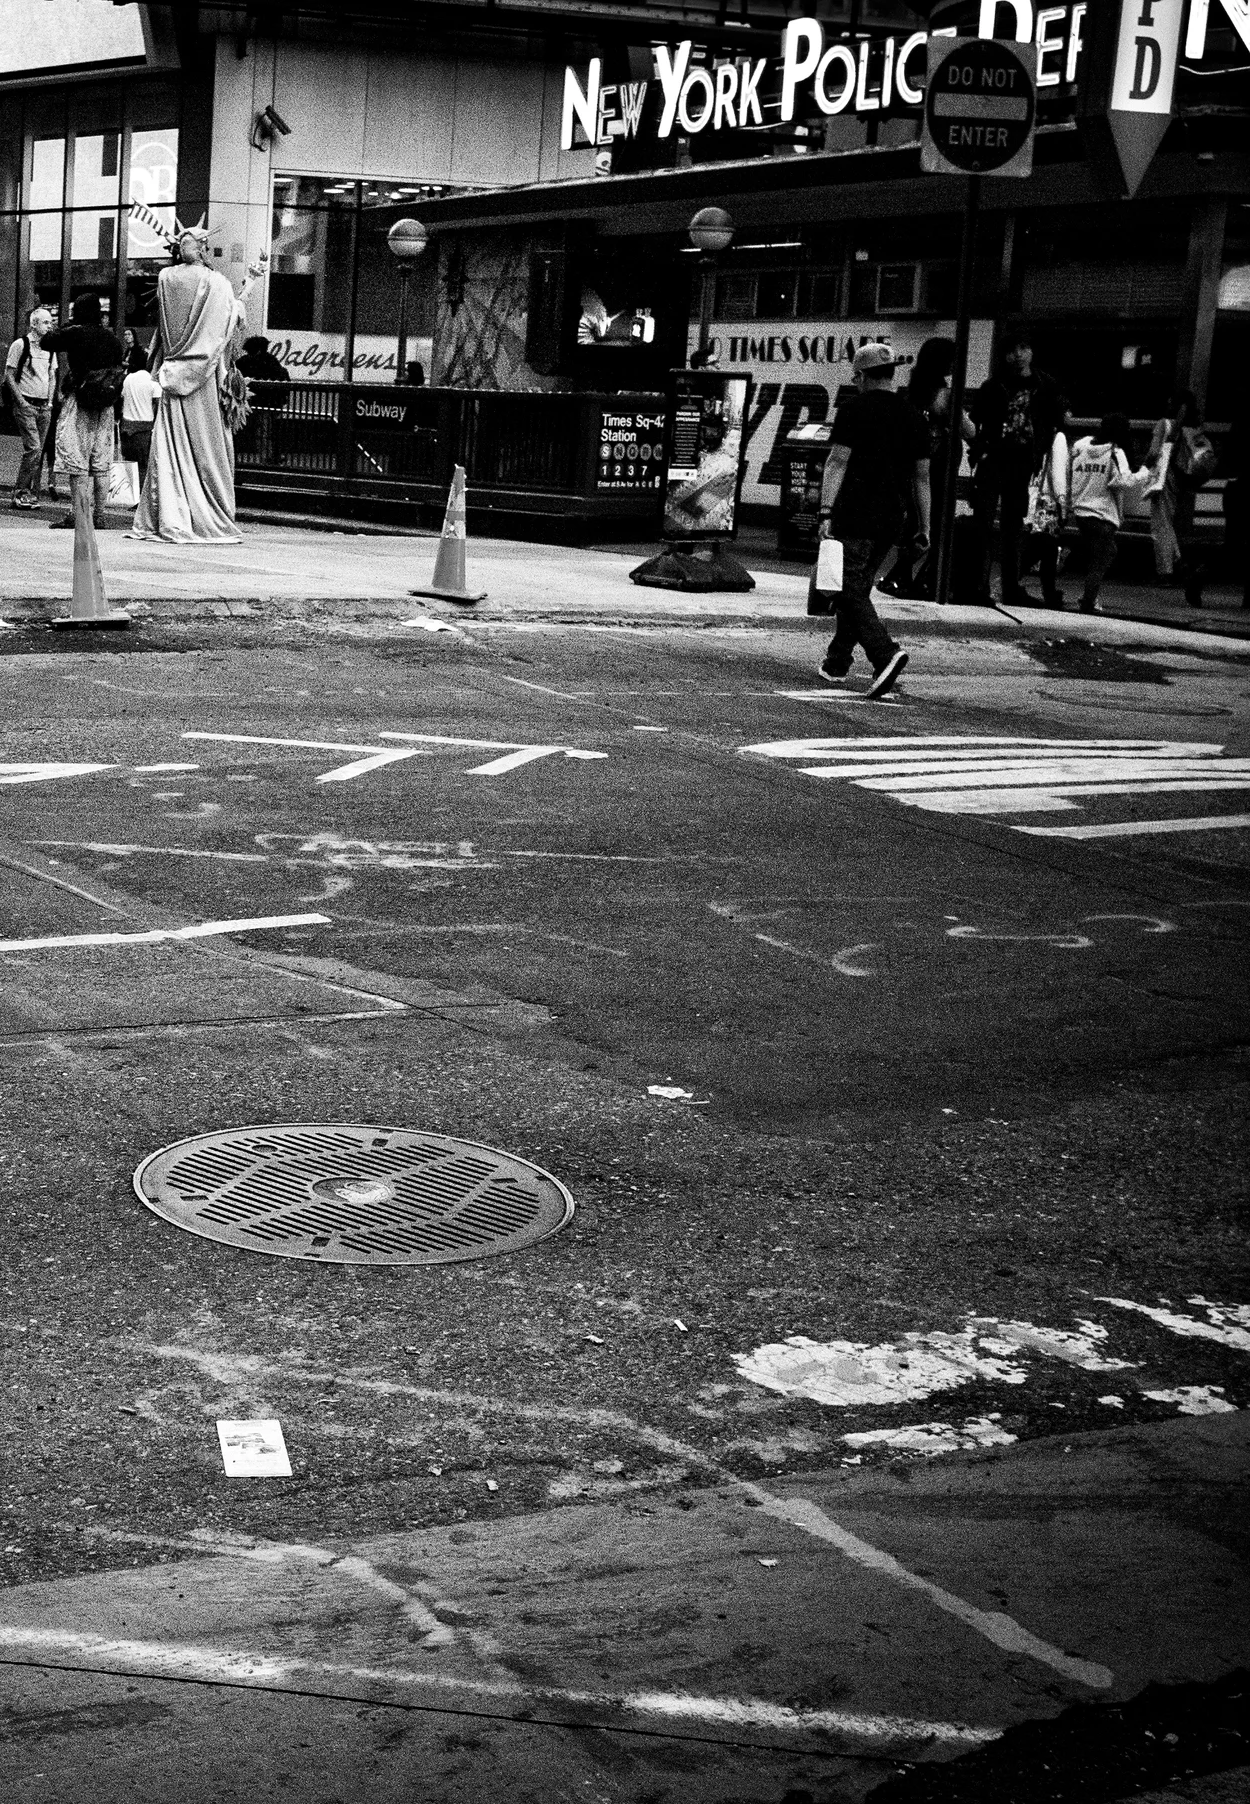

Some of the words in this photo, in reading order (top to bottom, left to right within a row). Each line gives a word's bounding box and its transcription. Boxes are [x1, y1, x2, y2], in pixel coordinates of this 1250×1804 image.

[561, 57, 648, 150] NEW
[655, 40, 767, 138] YORK
[780, 17, 957, 122] POLIC
[948, 65, 974, 86] DO
[981, 67, 1018, 89] NOT
[948, 124, 1009, 148] ENTER
[270, 339, 397, 376] Walgrens
[727, 335, 792, 363] TIMES
[355, 399, 407, 422] Subway
[602, 413, 632, 427] Times
[600, 428, 637, 442] Station
